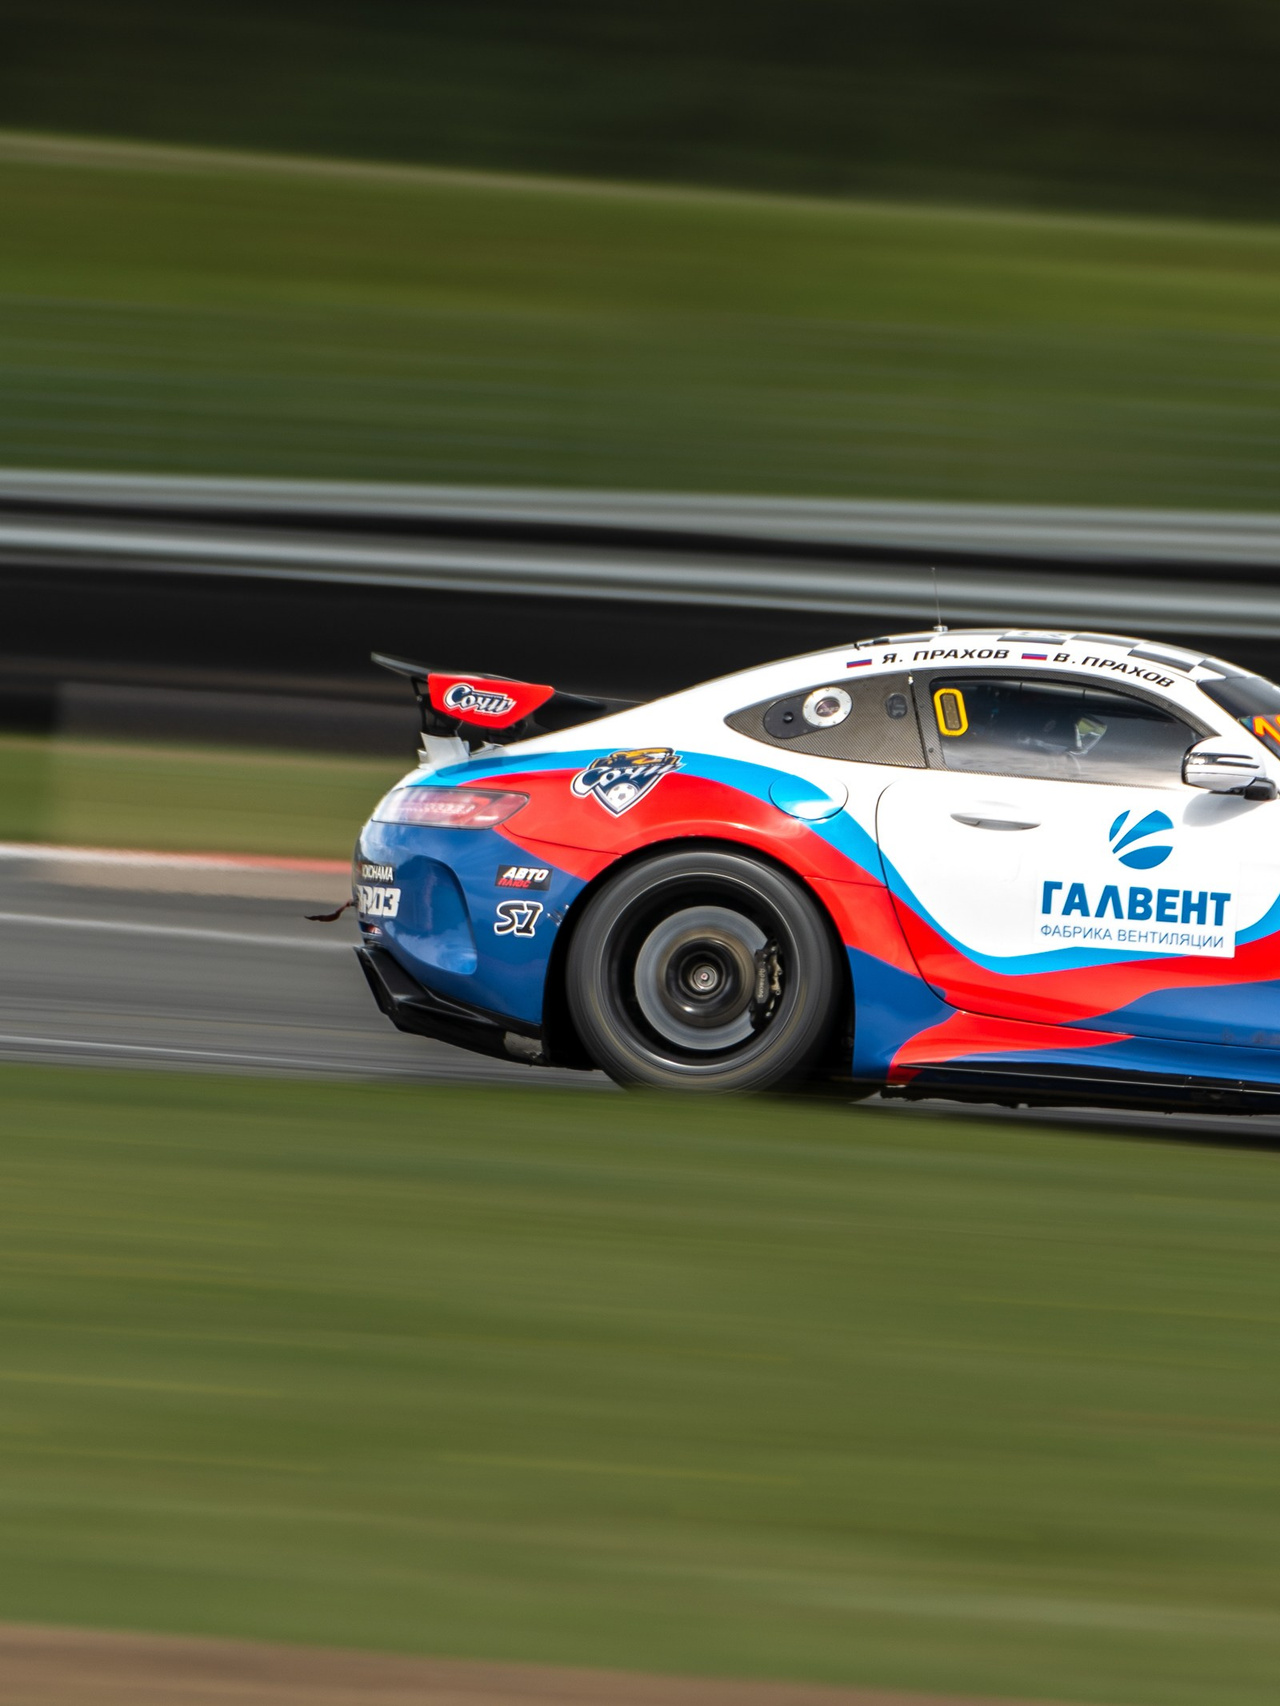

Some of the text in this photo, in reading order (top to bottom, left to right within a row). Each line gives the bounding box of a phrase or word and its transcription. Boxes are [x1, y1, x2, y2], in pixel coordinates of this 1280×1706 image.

[912, 648, 1010, 662] ПРАХОВ
[1081, 656, 1175, 688] ПРАХОВ
[503, 866, 549, 882] АВТО
[1040, 880, 1232, 926] ГАЛВЕНТ
[1040, 924, 1225, 950] ФАБРИКА ВЕНТИЛЯЦИИ
